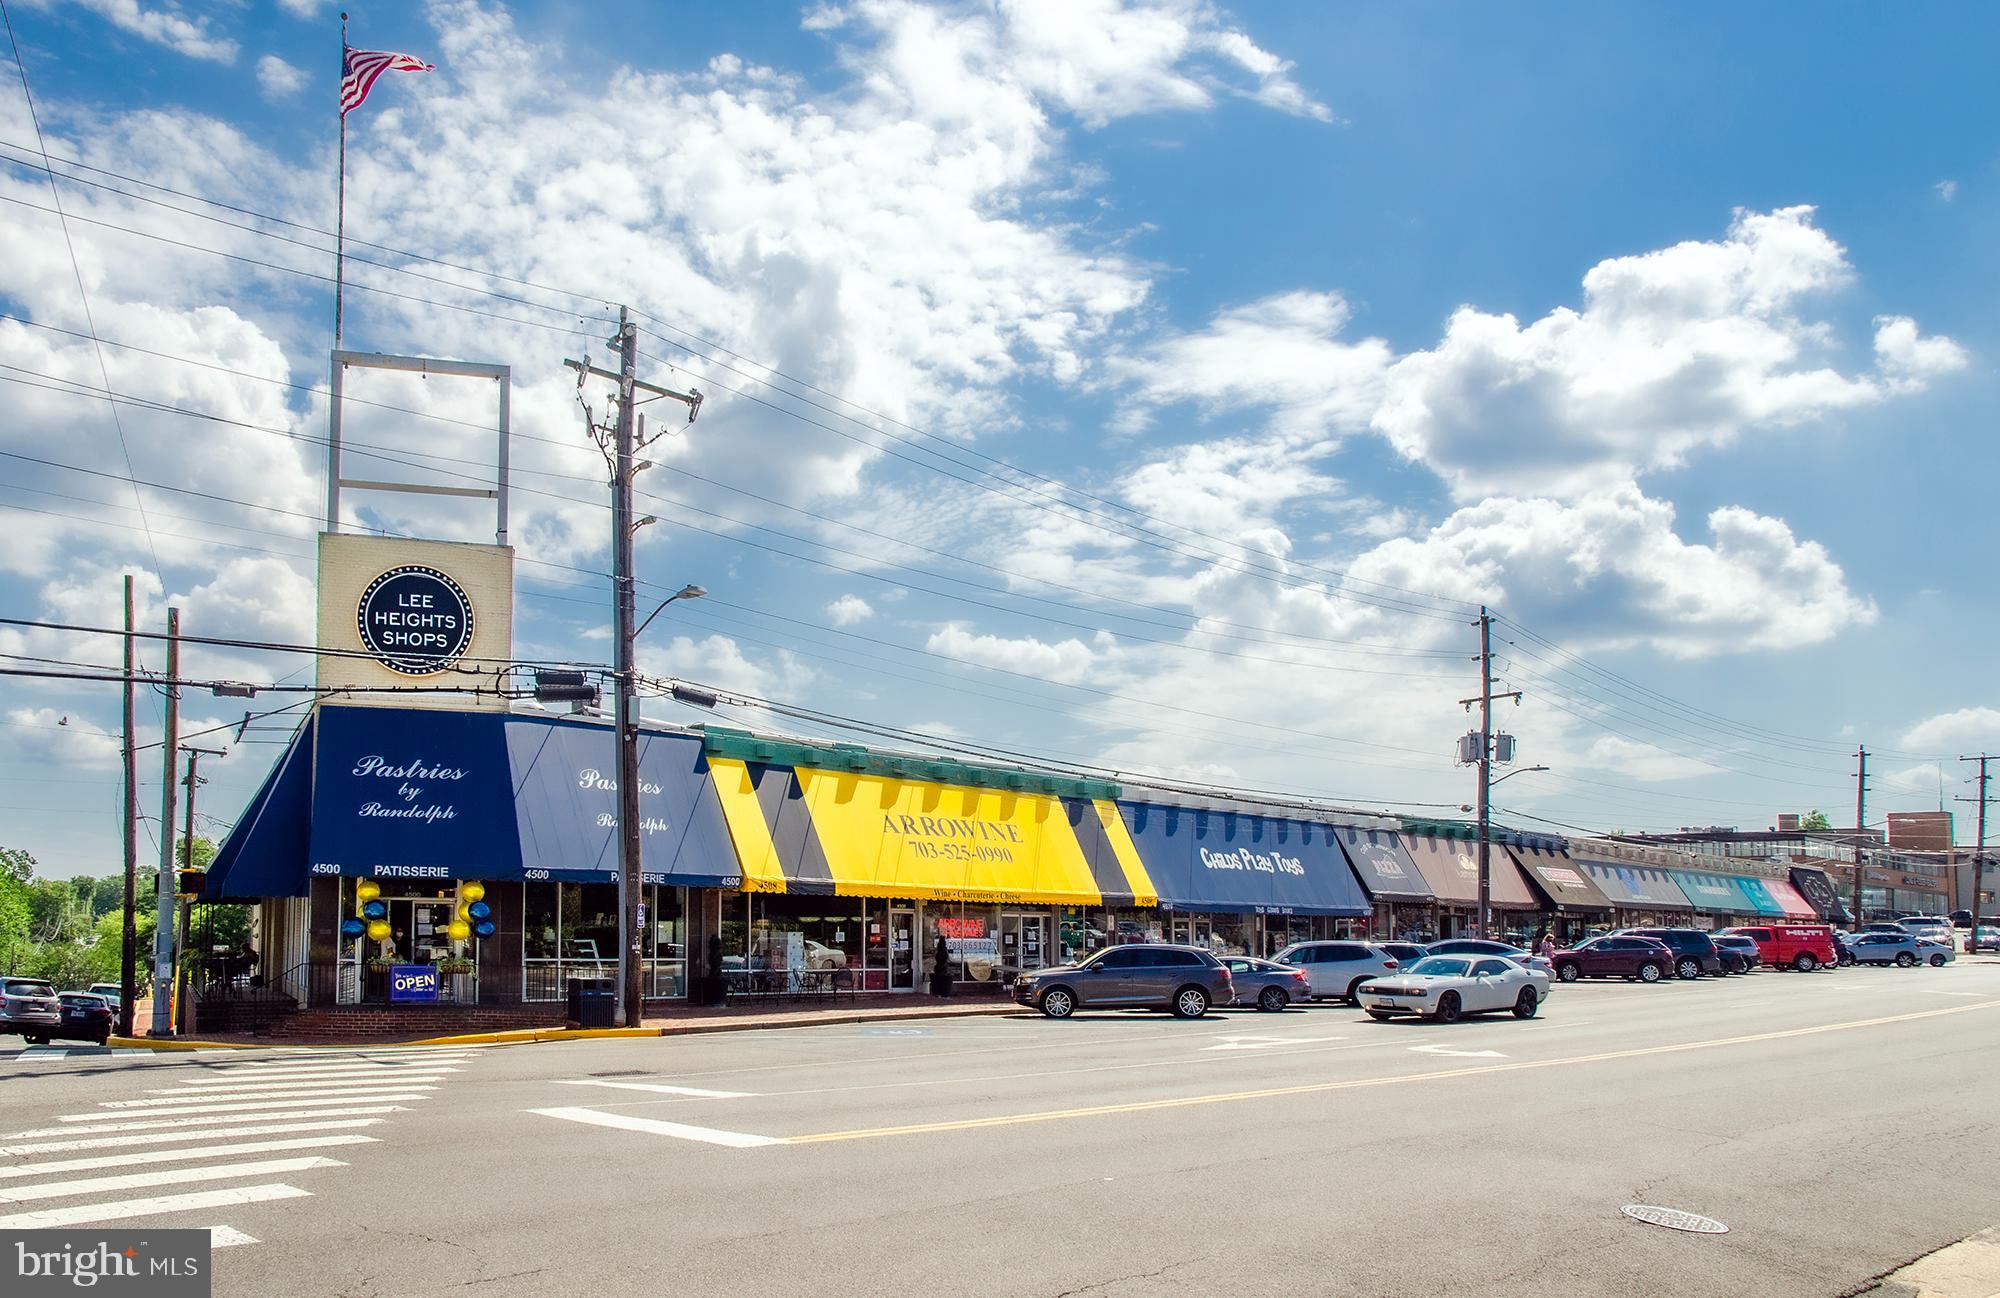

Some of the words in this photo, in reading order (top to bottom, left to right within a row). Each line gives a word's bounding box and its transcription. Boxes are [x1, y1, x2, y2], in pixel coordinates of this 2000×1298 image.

[398, 593, 434, 608] LEE
[374, 611, 456, 629] HEIGHTS
[382, 630, 447, 648] SHOPS
[352, 755, 470, 780] Pastries
[578, 768, 664, 795] Pasies
[398, 782, 424, 801] by
[358, 801, 459, 824] Randolph
[596, 812, 669, 835] Raolph
[883, 815, 1024, 843] ARROWINE
[908, 840, 1013, 863] 703-525-0990
[312, 863, 341, 874] 4500
[374, 865, 449, 878] PATISSERIE
[524, 868, 550, 880] 4500
[721, 876, 741, 887] 4500
[933, 888, 952, 897] Wine
[957, 890, 995, 900] Charcuterie
[1000, 892, 1021, 901] Cheese
[395, 974, 435, 991] OPEN
